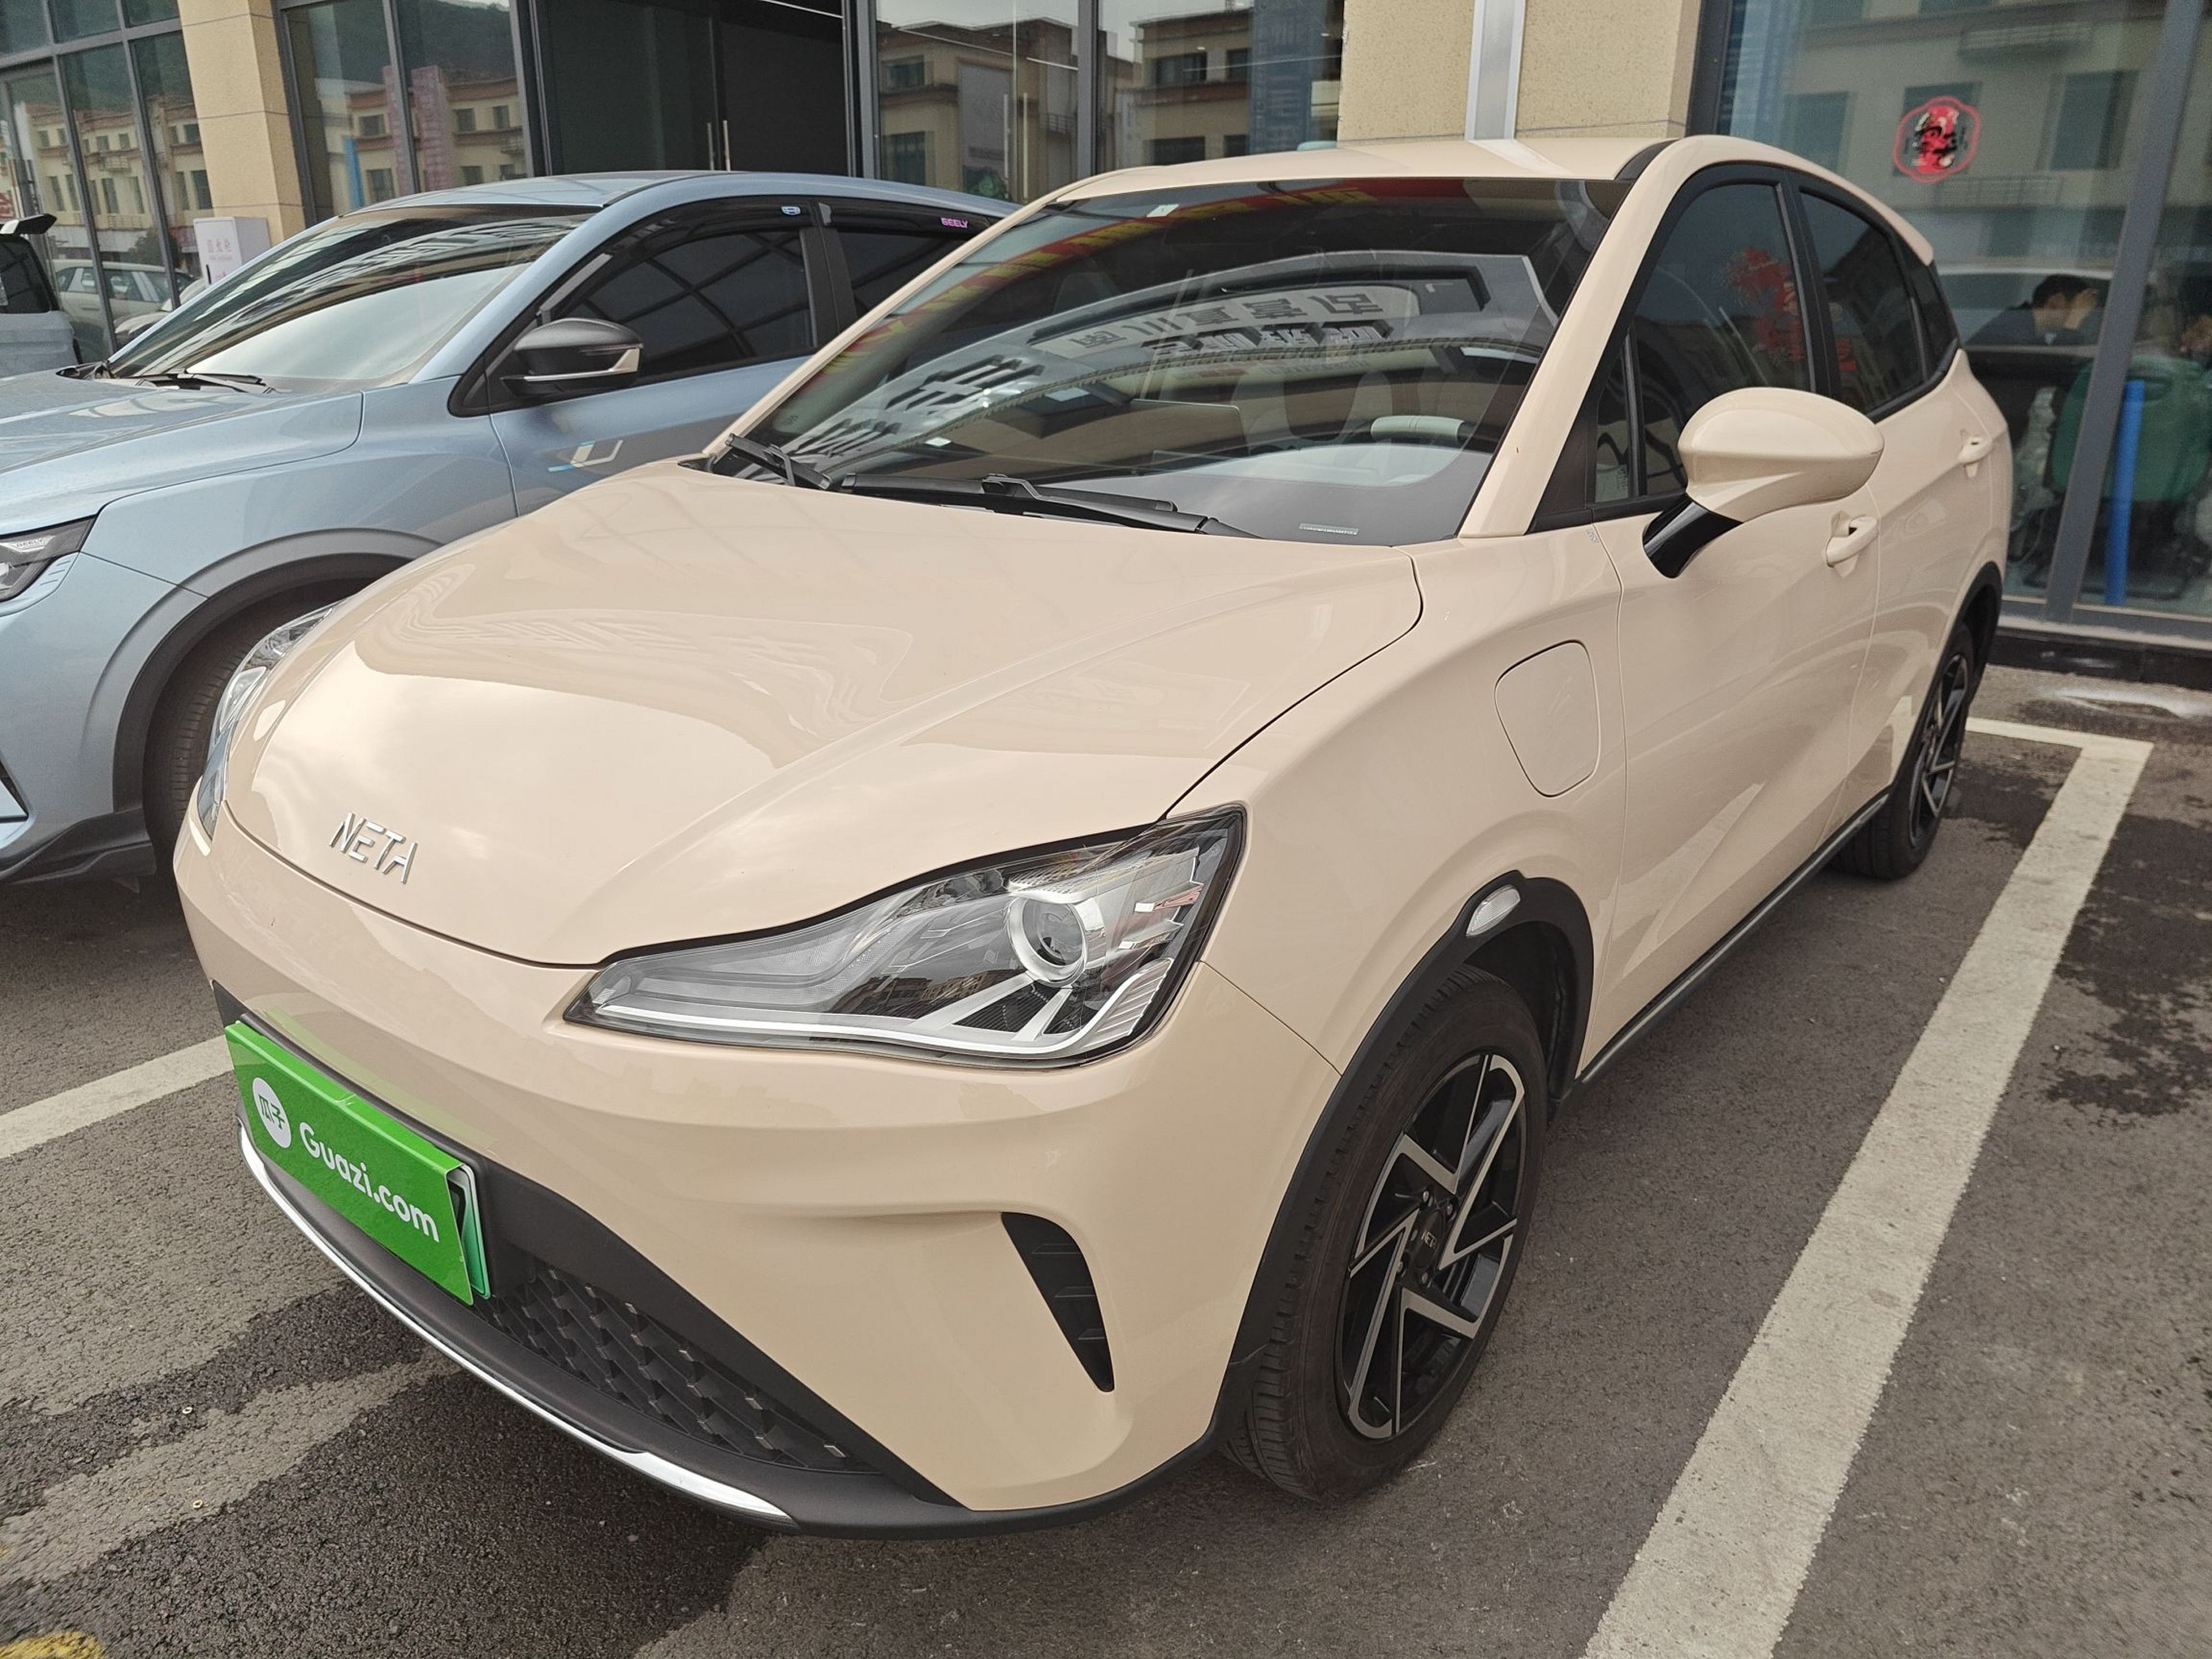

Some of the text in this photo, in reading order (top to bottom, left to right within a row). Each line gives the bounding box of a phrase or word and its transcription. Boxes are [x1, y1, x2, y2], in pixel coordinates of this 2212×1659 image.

[941, 218, 968, 228] GEELY
[329, 811, 418, 885] NETA
[258, 1093, 285, 1130] 瓜子
[299, 1122, 440, 1243] Guazi.com
